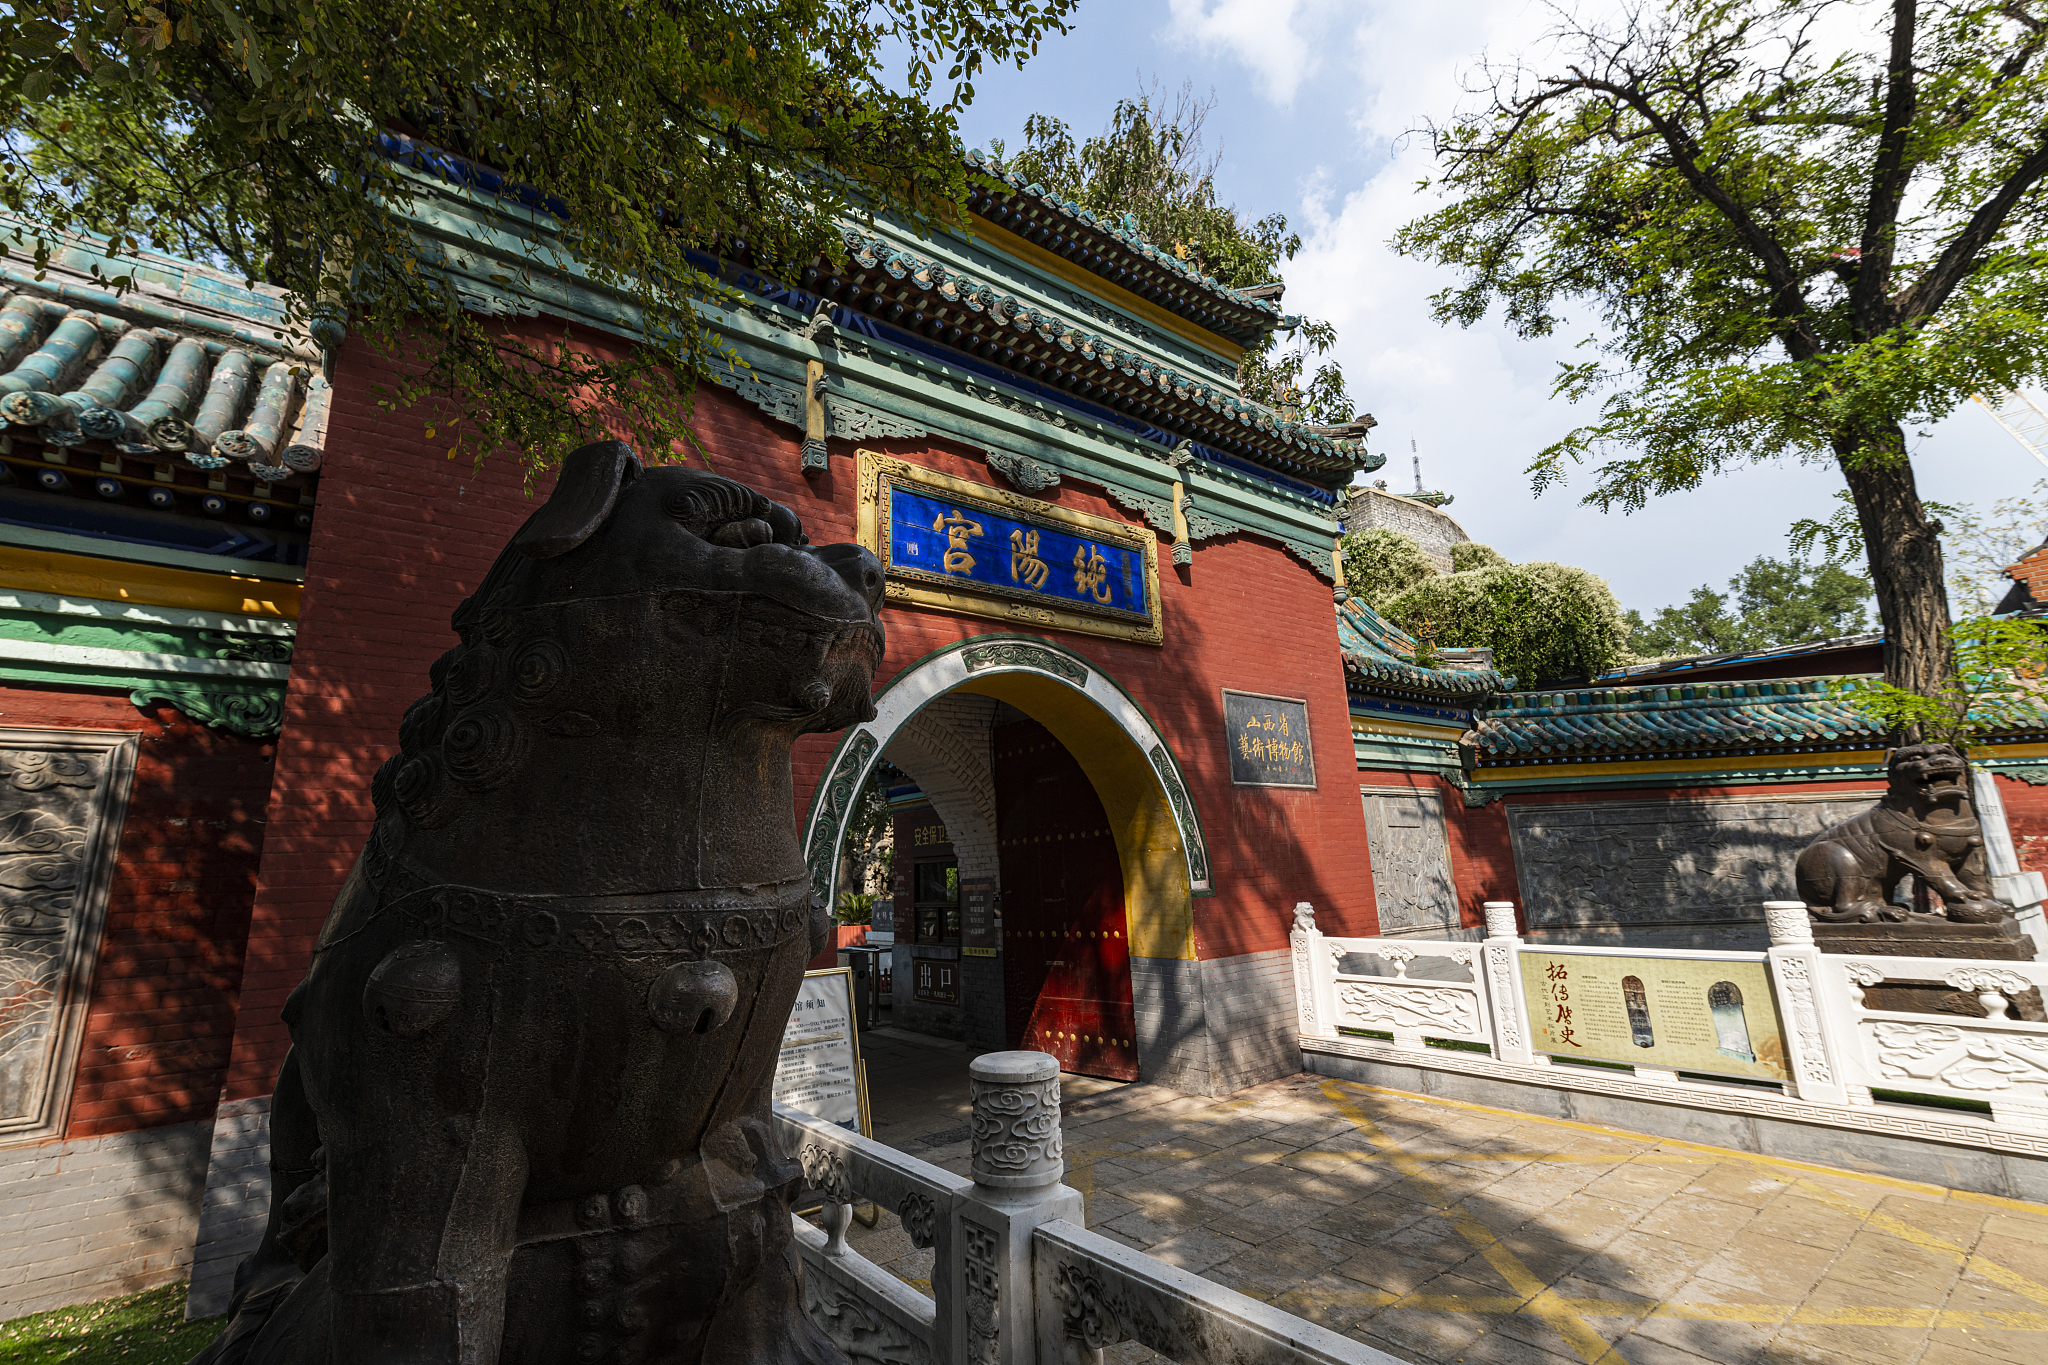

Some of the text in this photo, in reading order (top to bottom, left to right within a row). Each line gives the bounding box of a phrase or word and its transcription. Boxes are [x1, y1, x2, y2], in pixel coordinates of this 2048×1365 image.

[1246, 712, 1289, 737] 山西省
[920, 963, 952, 989] 出口
